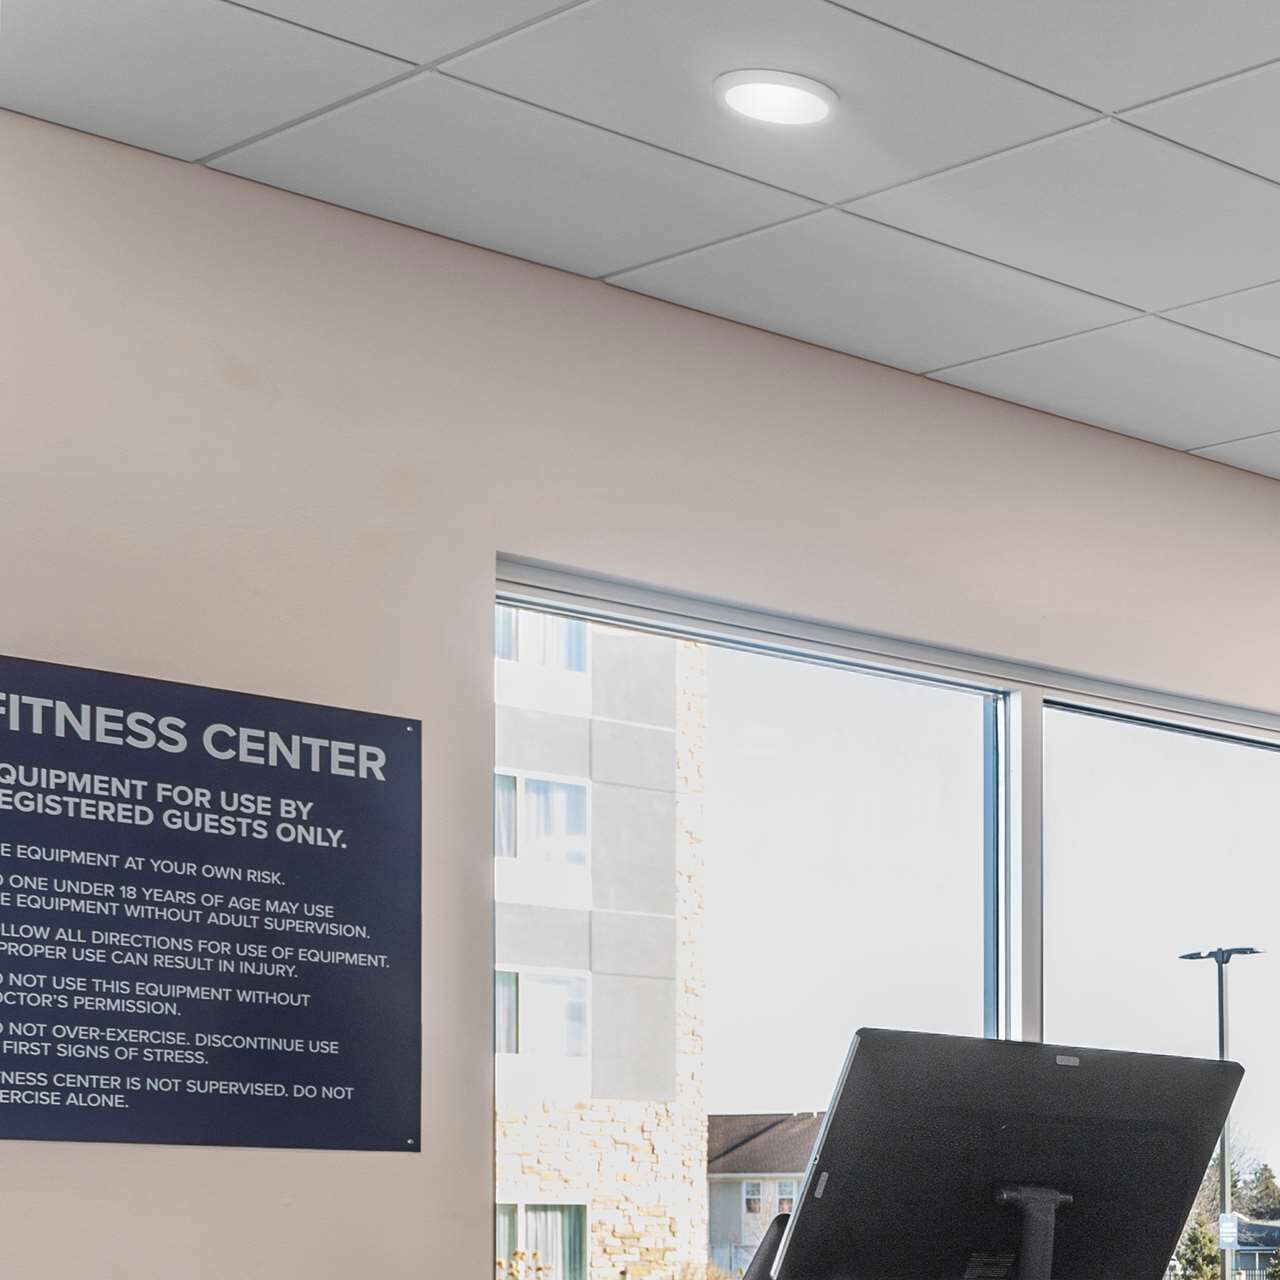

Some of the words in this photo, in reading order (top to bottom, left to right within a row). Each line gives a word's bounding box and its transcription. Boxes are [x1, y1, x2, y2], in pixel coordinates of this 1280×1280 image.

[0, 691, 188, 754] ITNESS
[202, 723, 386, 782] CENTER
[157, 782, 212, 809] FOR
[220, 790, 272, 816] USE
[280, 798, 314, 821] BY
[162, 808, 268, 840] GUESTS
[275, 822, 347, 849] ONLY.
[16, 844, 120, 868] EQUIPMENT
[124, 856, 146, 871] AT
[150, 858, 197, 876] YOUR
[201, 864, 242, 881] OWN
[247, 869, 286, 886] RISK.
[9, 874, 49, 891] ONE
[53, 878, 115, 898] UNDER
[119, 885, 137, 900] 18
[141, 887, 197, 905] YEARS
[200, 893, 224, 907] OF
[227, 896, 261, 912] AGE
[265, 899, 300, 915] MAY
[303, 903, 335, 919] USE
[16, 893, 120, 916] EQUIPMENT
[123, 903, 204, 924] WITHOUT
[207, 911, 260, 929] ADULT
[264, 916, 371, 939] SUPERVISION.
[54, 927, 87, 943] ALL
[91, 930, 194, 952] DIRECTIONS
[198, 939, 232, 955] FOR
[236, 943, 267, 958] USE
[271, 946, 294, 960] OF
[298, 948, 390, 968] EQUIPMENT.
[72, 947, 107, 963] USE
[111, 950, 148, 966] CAN
[153, 953, 214, 971] RESULT
[218, 959, 235, 973] IN
[239, 961, 298, 978] INJURY.
[0, 991, 69, 1009] CTOR'S
[73, 995, 181, 1016] PERMISSION.
[9, 972, 48, 988] NOT
[52, 975, 87, 992] USE
[91, 978, 131, 994] THIS
[135, 981, 233, 1001] EQUIPMENT
[236, 989, 311, 1007] WITHOUT
[2, 1040, 52, 1056] FIRST
[56, 1043, 110, 1059] SIGNS
[114, 1046, 139, 1061] OF
[143, 1047, 209, 1065] STRESS.
[9, 1021, 48, 1037] NOT
[51, 1024, 191, 1046] OVER-EXERCISE.
[195, 1033, 304, 1052] DISCONTINUE
[308, 1040, 339, 1054] USE
[52, 1073, 122, 1090] CENTER
[126, 1076, 142, 1091] IS
[146, 1077, 182, 1092] NOT
[186, 1079, 289, 1097] SUPERVISED.
[293, 1084, 317, 1098] DO
[321, 1086, 355, 1100] NOT
[65, 1092, 129, 1108] ALONE.
